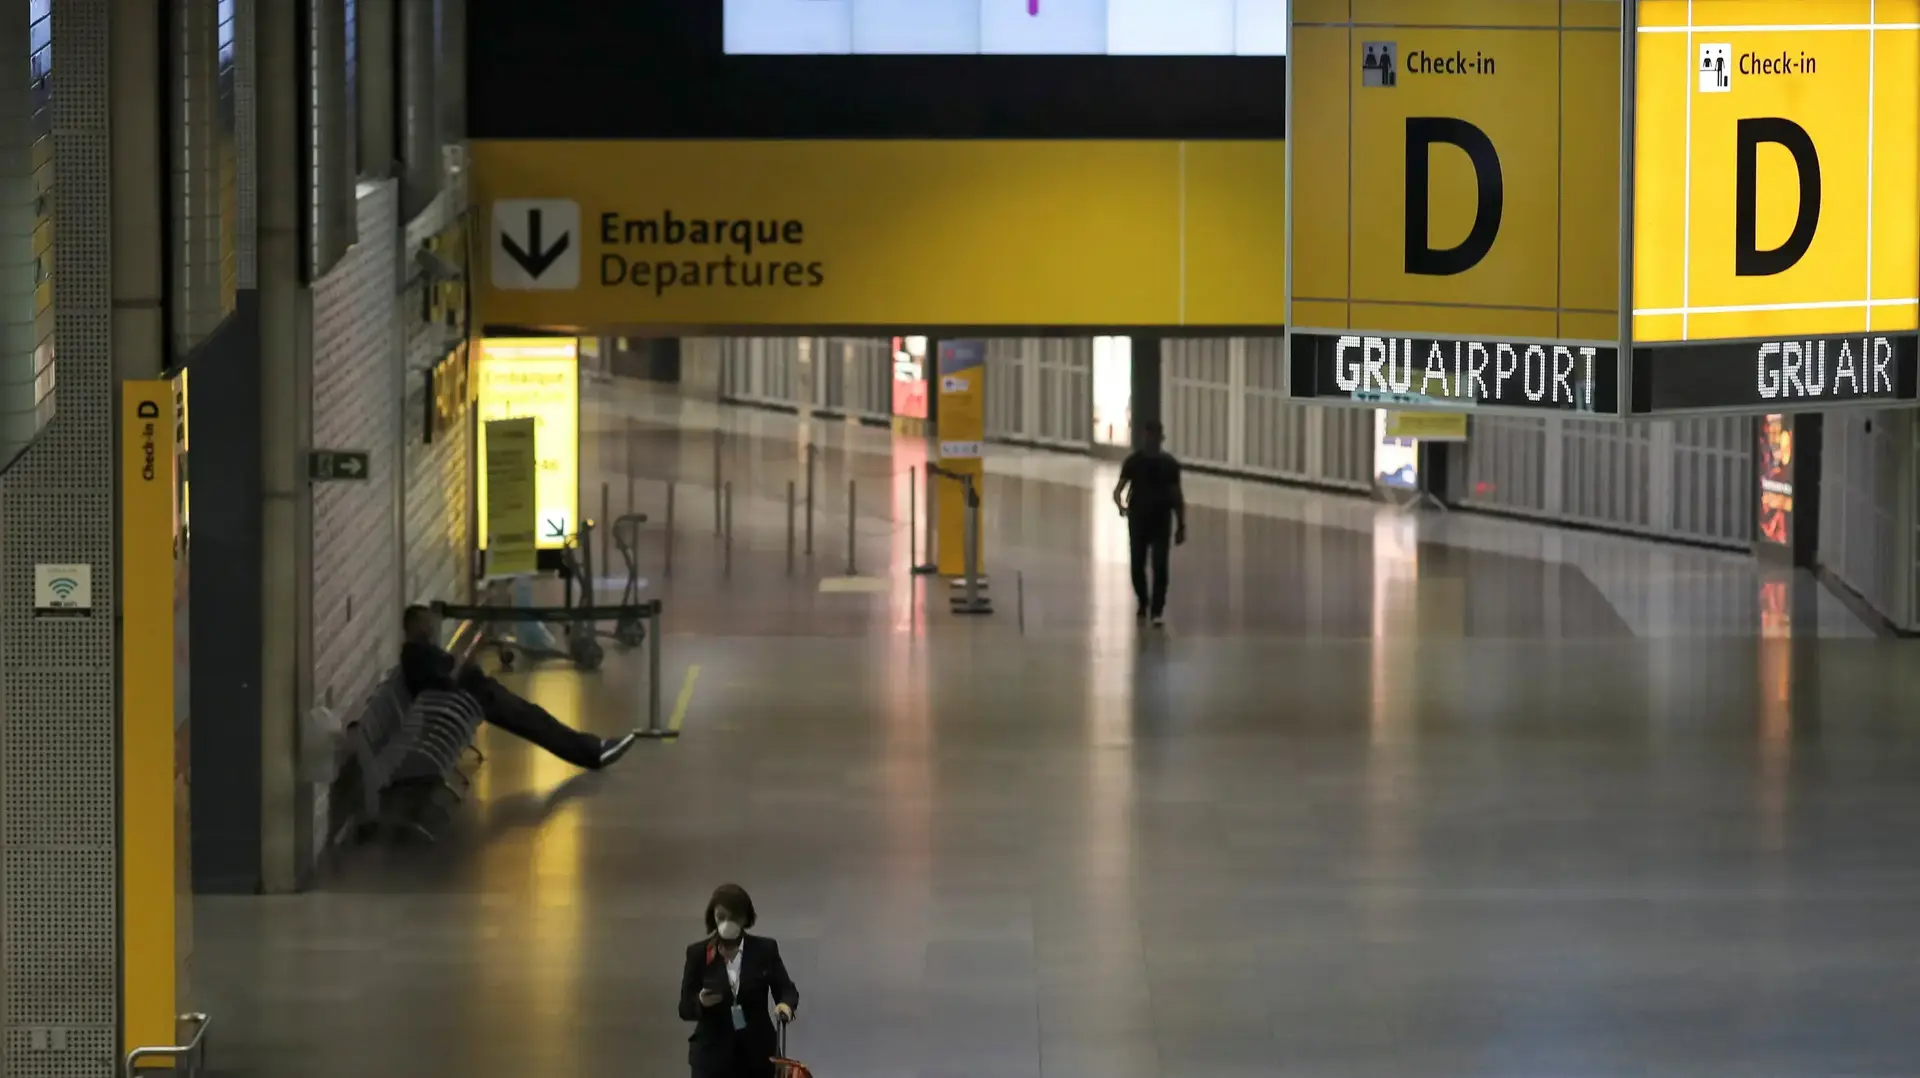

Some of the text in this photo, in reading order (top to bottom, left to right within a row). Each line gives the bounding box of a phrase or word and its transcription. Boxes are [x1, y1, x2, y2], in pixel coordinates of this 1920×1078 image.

[1406, 50, 1495, 75] Check-in
[1739, 51, 1816, 75] Check-in
[1404, 116, 1503, 276] D
[1735, 117, 1821, 277] D
[600, 209, 803, 254] Embarque
[600, 253, 824, 297] Departures
[1335, 335, 1597, 405] GRU AIRPORT
[1757, 337, 1892, 398] GRU AIR
[137, 400, 160, 481] Check-in D
